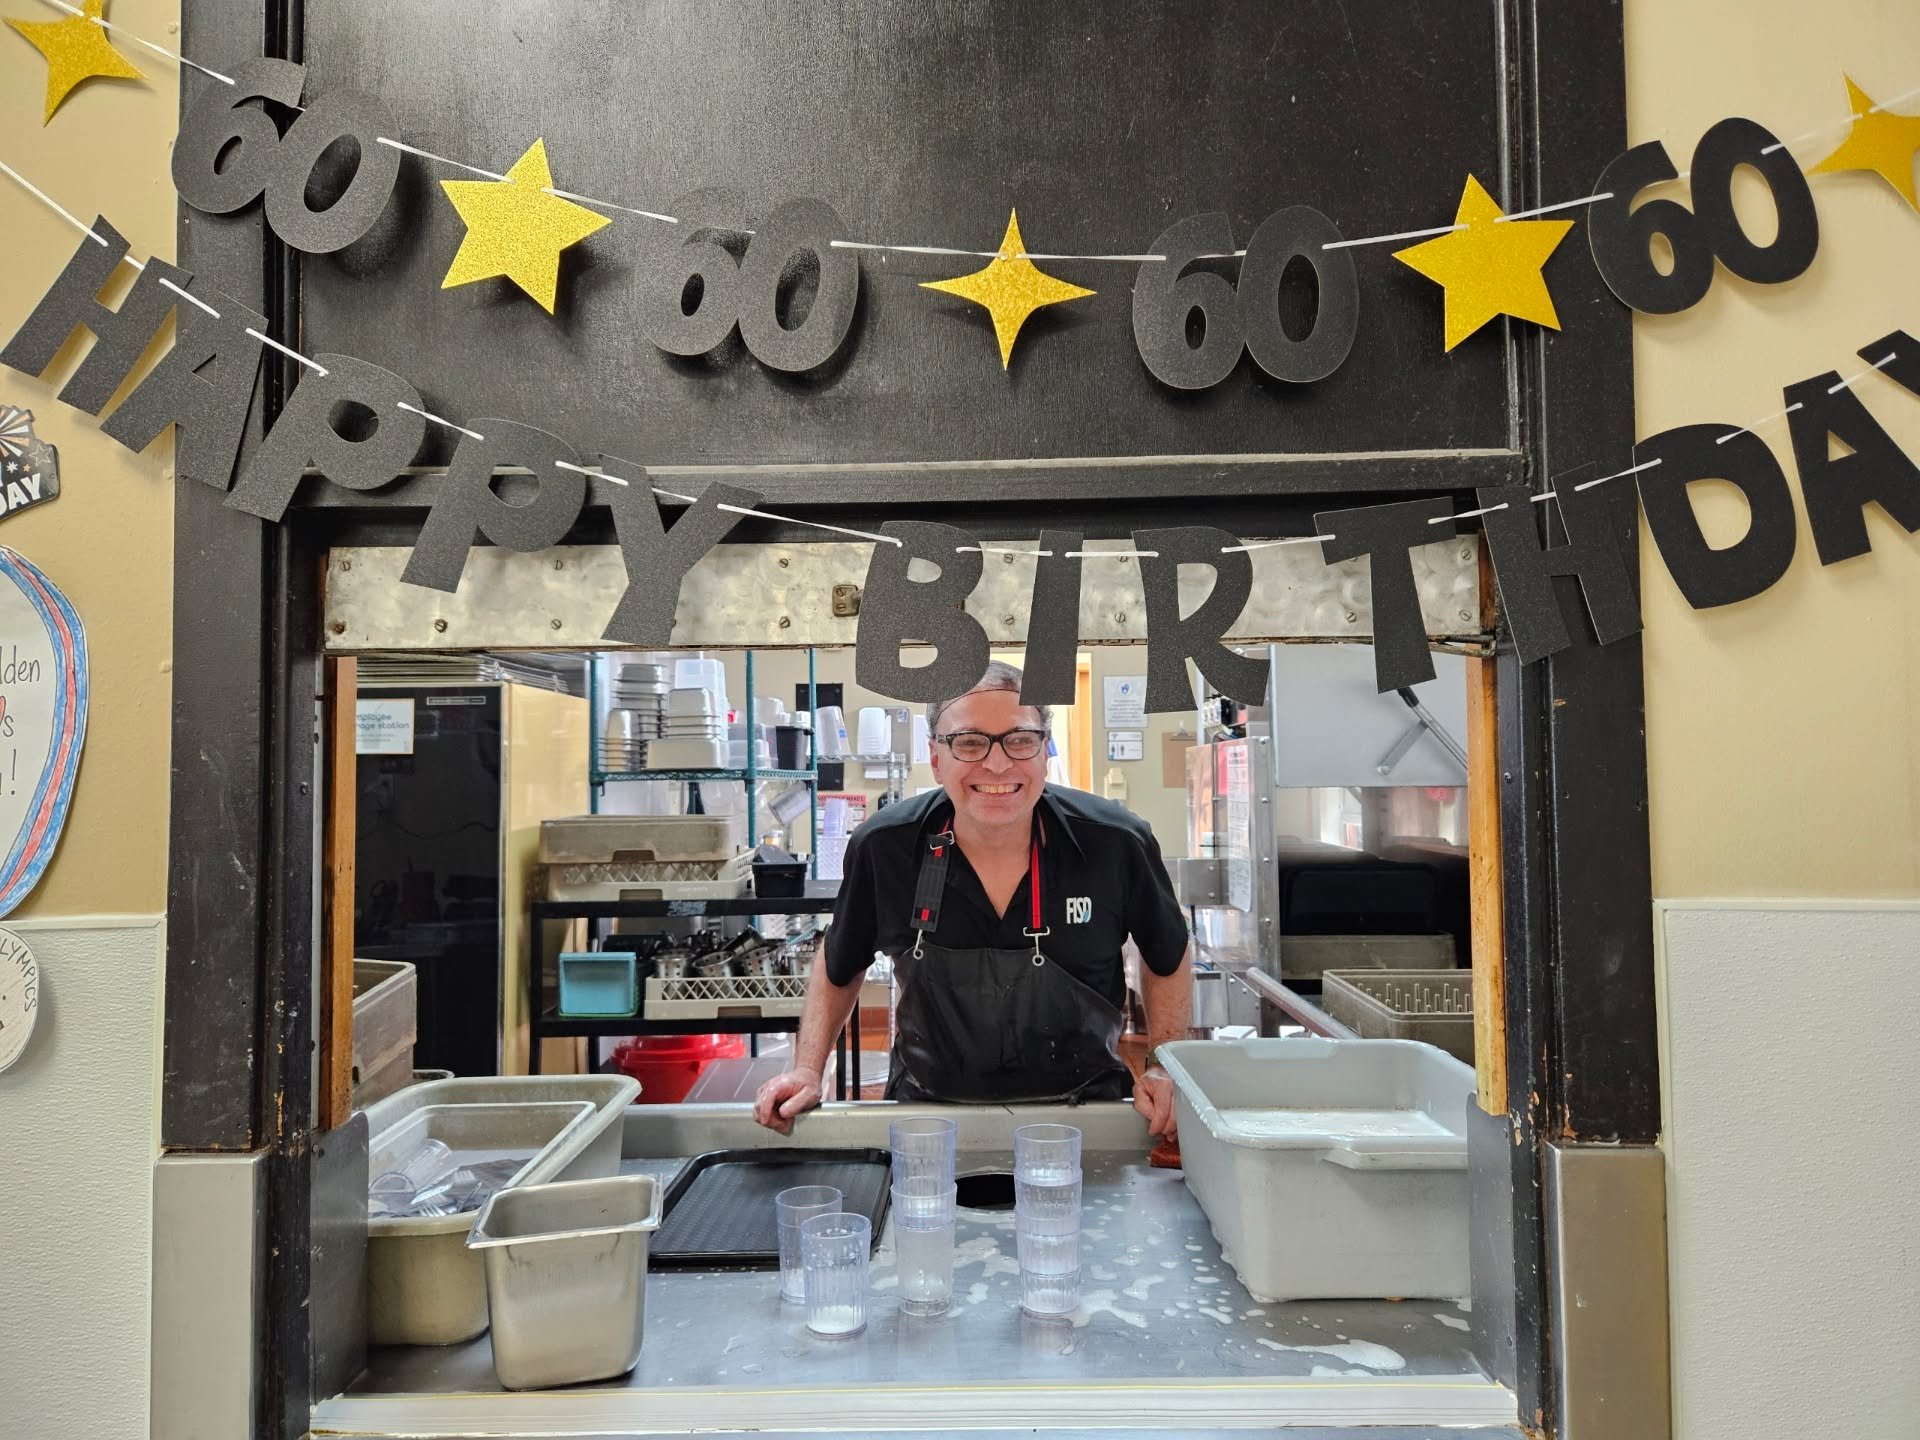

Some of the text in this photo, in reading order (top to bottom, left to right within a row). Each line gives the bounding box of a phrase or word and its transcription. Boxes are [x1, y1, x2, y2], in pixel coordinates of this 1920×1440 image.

[172, 57, 402, 254] 60
[1588, 117, 1820, 315] 60
[644, 190, 859, 372] 60
[1132, 204, 1360, 390] 60
[0, 214, 764, 646] HAPPY
